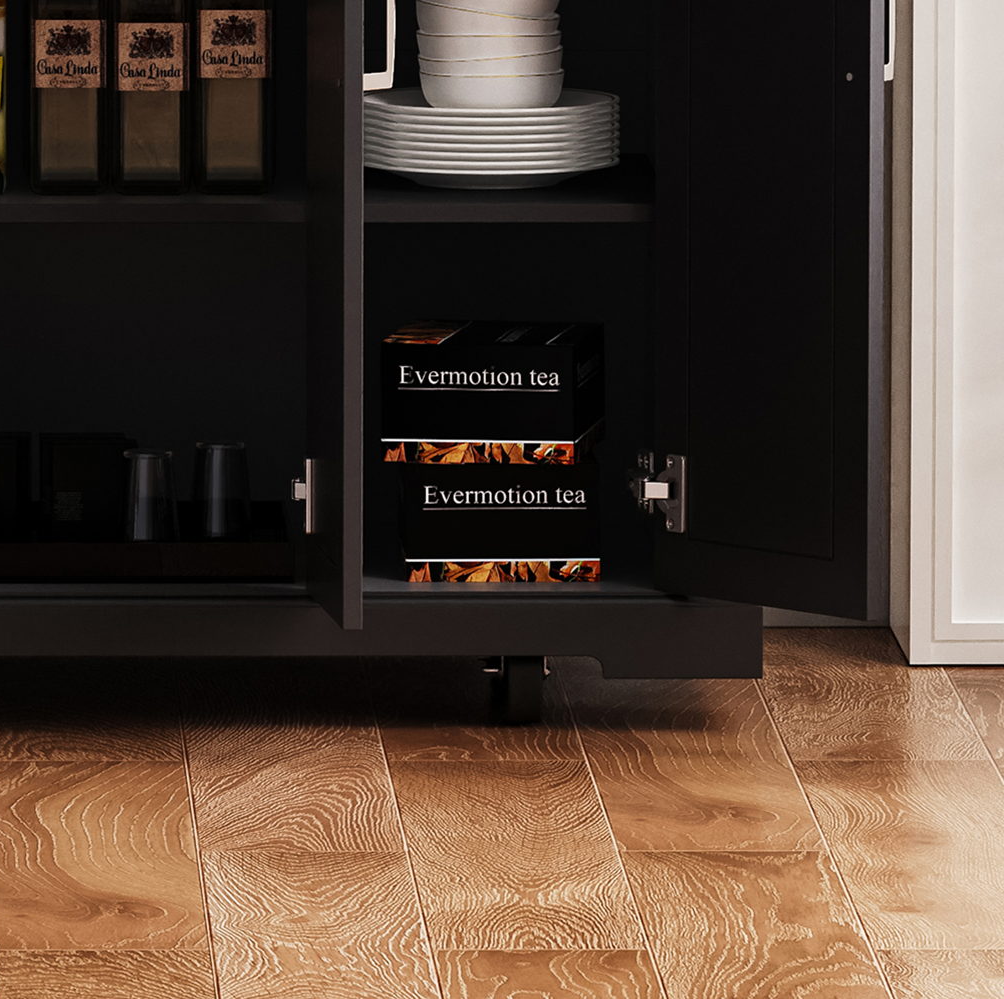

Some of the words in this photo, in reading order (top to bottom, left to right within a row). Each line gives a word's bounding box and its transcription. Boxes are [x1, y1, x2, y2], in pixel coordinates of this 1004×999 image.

[202, 49, 228, 65] Casa
[229, 50, 264, 67] Linda
[37, 59, 63, 76] Casa
[64, 60, 98, 77] Linda
[120, 62, 146, 78] Casa
[147, 63, 181, 80] Linda
[398, 365, 522, 387] Evermotion
[529, 368, 561, 387] tea
[423, 484, 548, 505] Evermotion
[555, 487, 587, 504] tea
